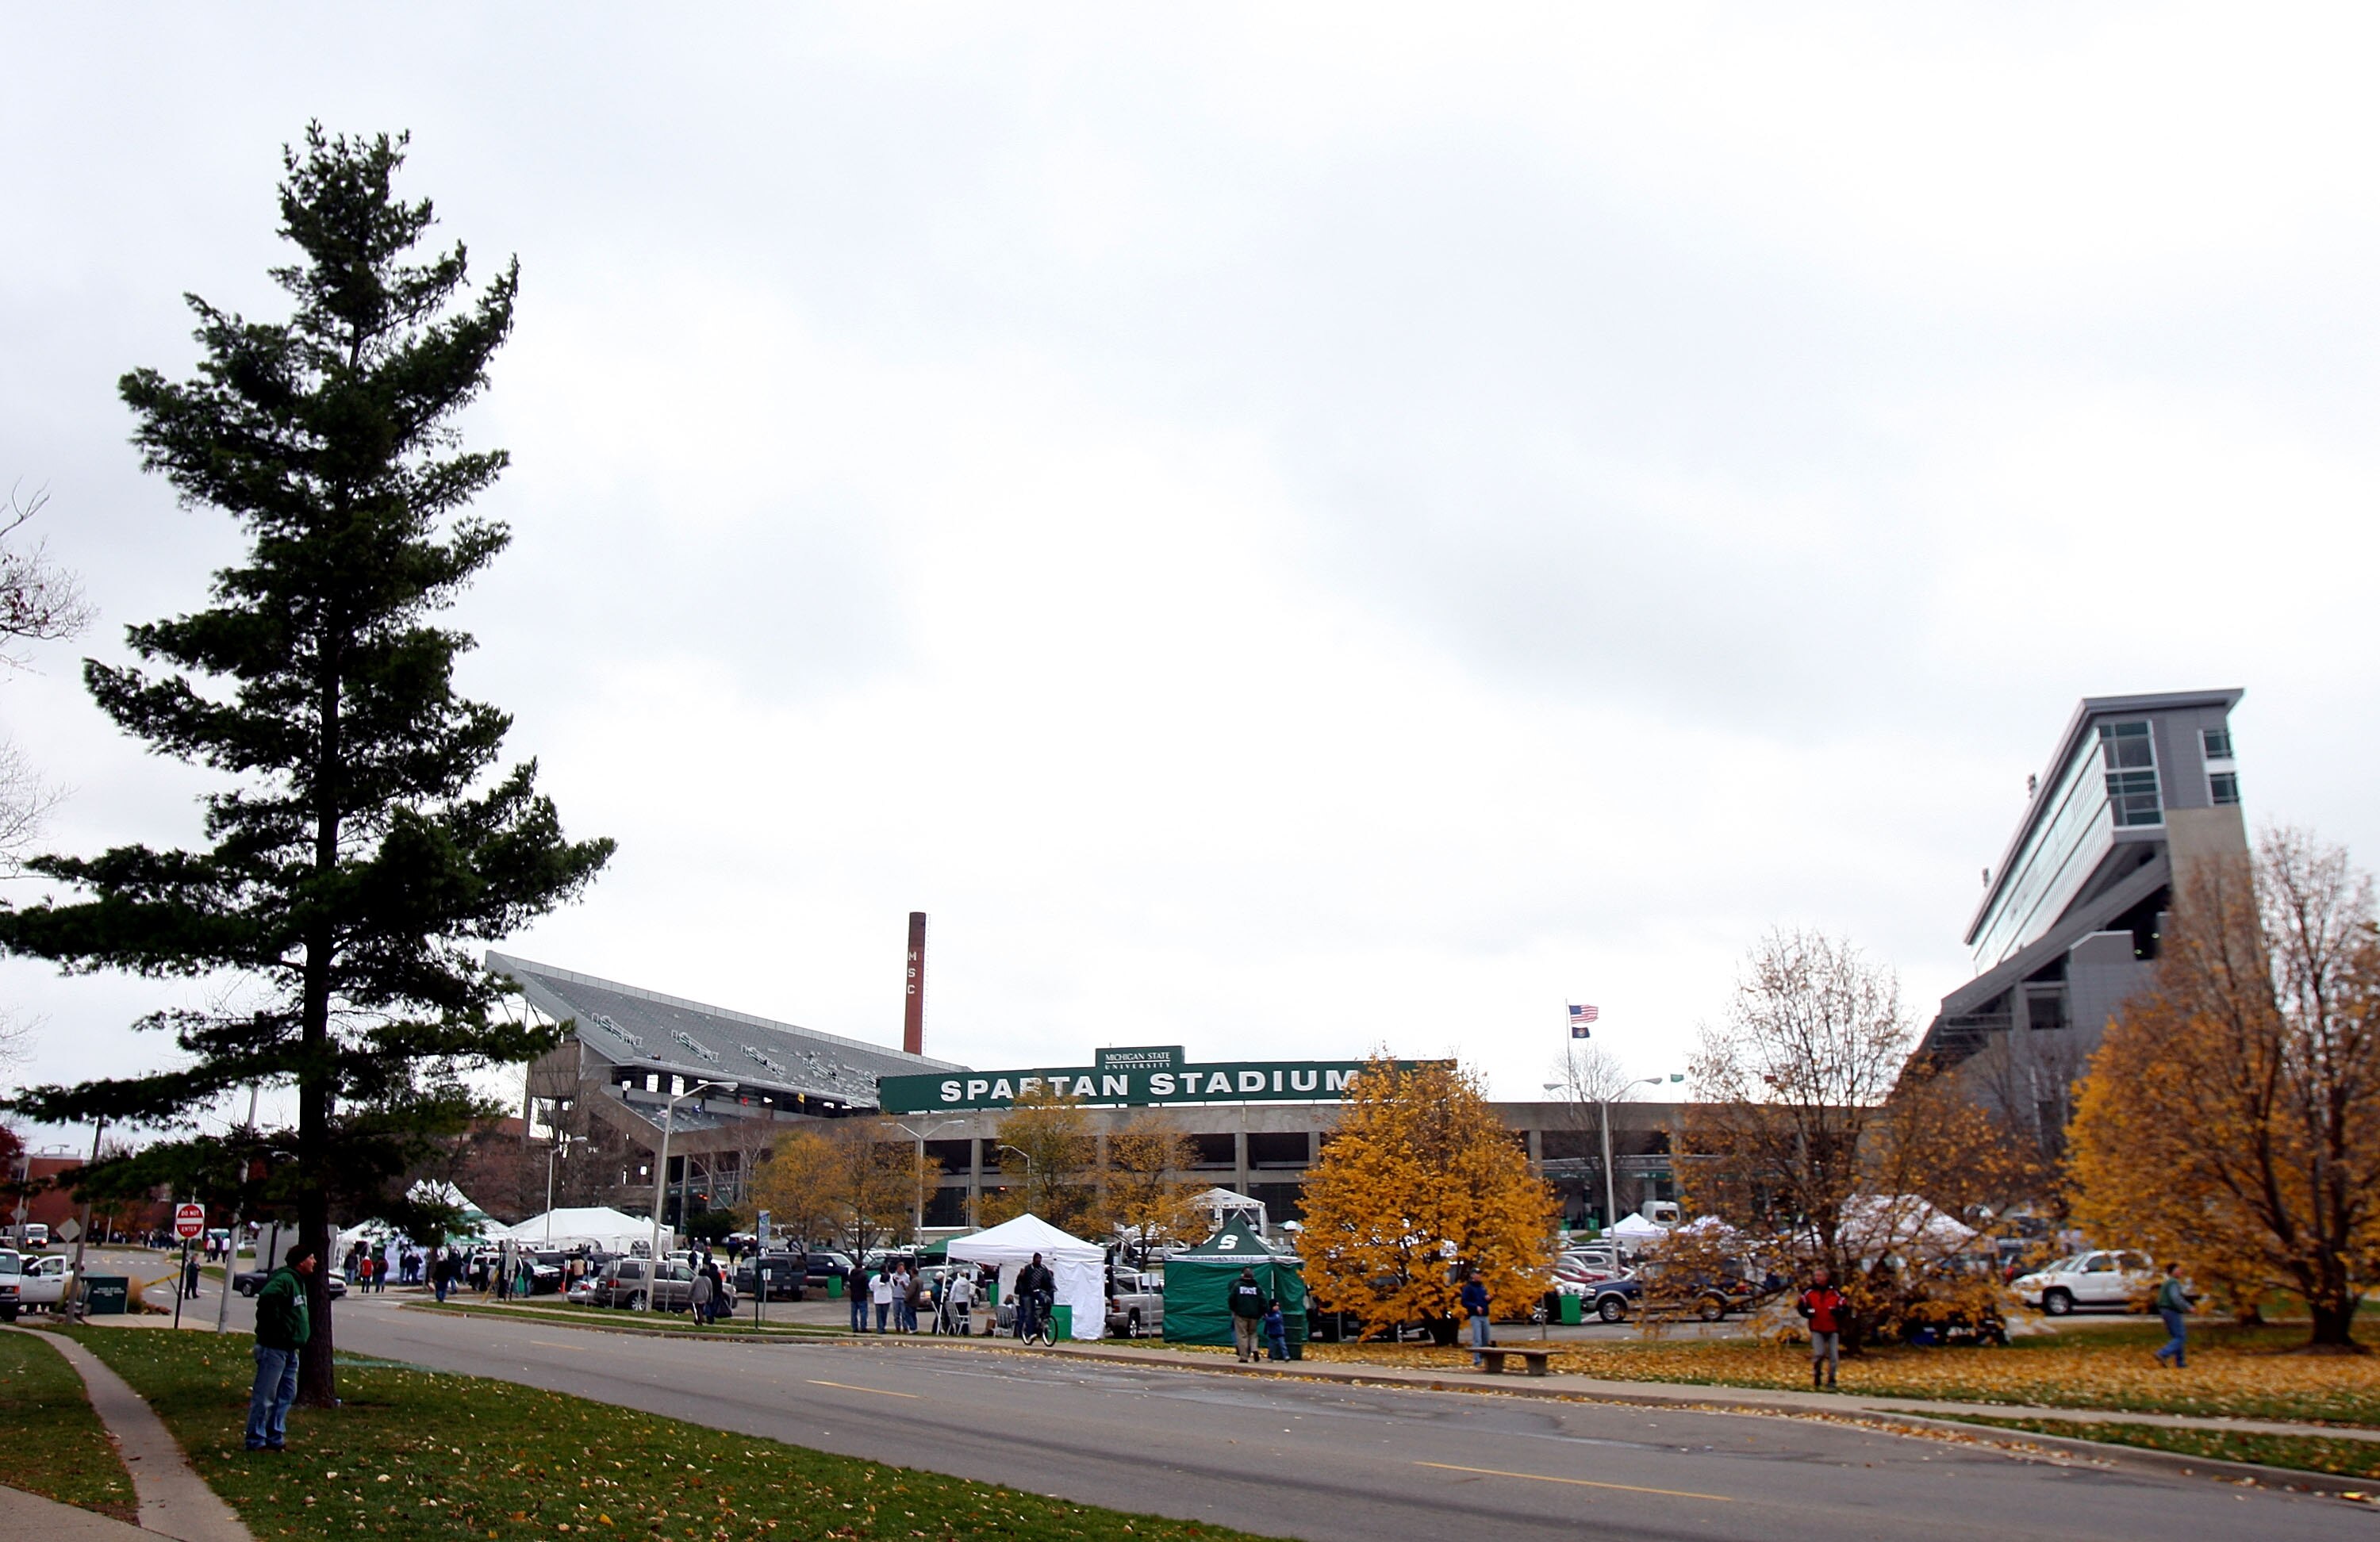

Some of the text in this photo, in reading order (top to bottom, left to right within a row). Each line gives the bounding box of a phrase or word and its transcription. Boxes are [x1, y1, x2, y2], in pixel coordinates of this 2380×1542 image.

[1105, 1053, 1145, 1061] MICHIGAN
[940, 1070, 1359, 1103] SPARTAN STADIUM
[1218, 1234, 1238, 1250] S
